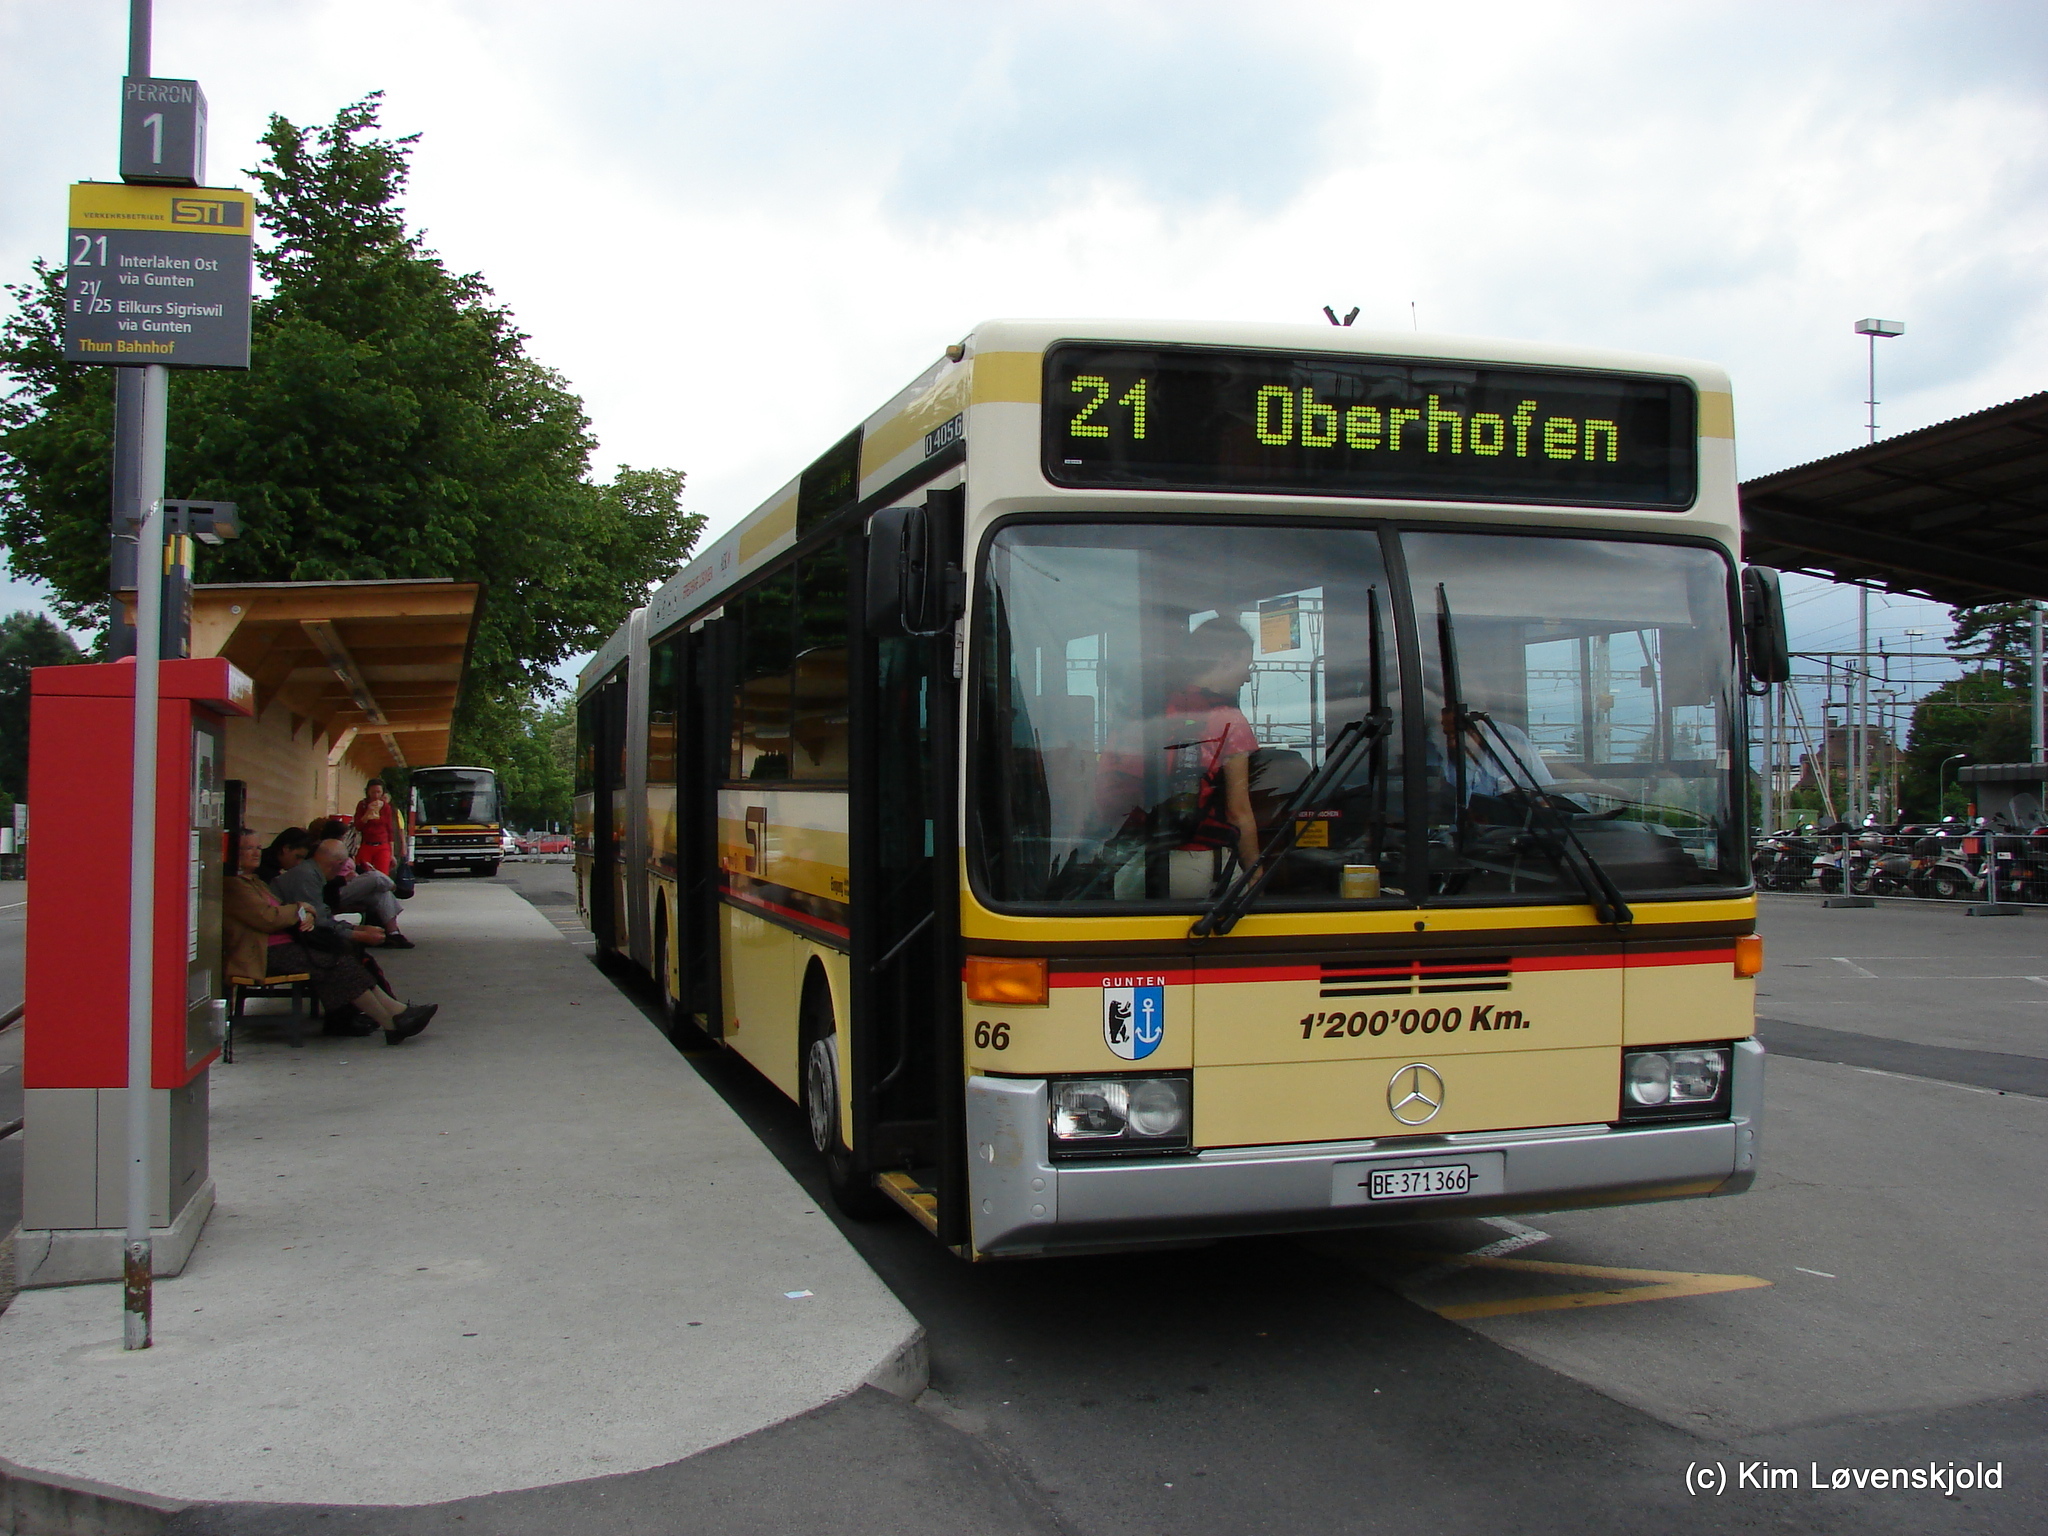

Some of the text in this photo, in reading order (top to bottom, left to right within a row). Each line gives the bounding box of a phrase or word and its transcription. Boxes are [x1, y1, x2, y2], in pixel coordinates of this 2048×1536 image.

[127, 83, 192, 103] PERRON
[143, 112, 164, 164] 1
[83, 212, 165, 221] VERKEHRSBETRIEBE
[176, 200, 224, 224] STI
[73, 234, 108, 267] 21
[120, 255, 218, 271] Interlaken Ost
[119, 272, 195, 287] via Gunten
[73, 299, 82, 312] E
[118, 300, 163, 314] Eilkurs
[166, 302, 223, 318] Sigriswil
[118, 318, 192, 333] via Gunten
[79, 338, 175, 354] Thun Bahnhof
[1070, 375, 1617, 462] 21 Oberhofen
[1102, 976, 1165, 987] GUNTEN
[1469, 1005, 1530, 1031] Km.
[974, 1020, 1011, 1050] 66
